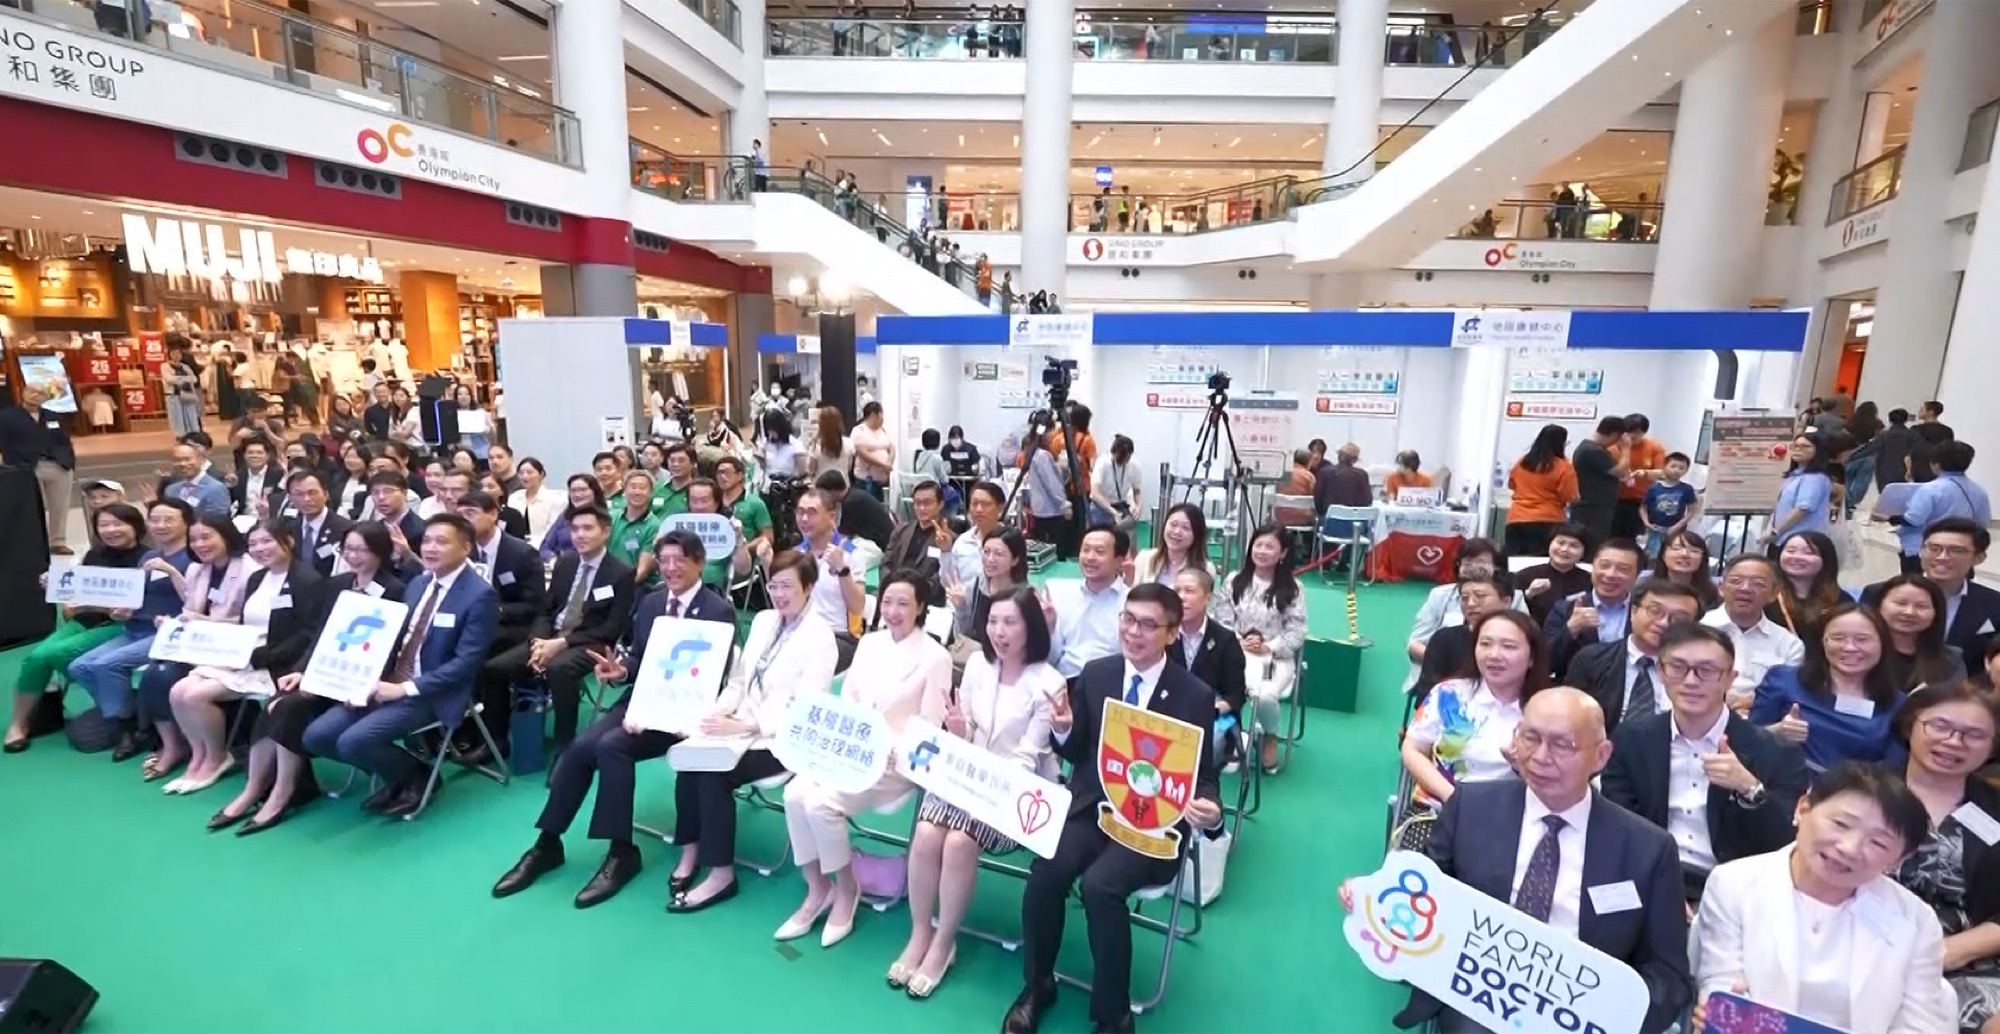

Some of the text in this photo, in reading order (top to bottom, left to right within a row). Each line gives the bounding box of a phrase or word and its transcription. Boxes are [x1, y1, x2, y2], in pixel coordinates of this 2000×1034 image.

[45, 41, 144, 76] GROUP
[357, 123, 415, 164] OC
[418, 159, 501, 191] Olympian City
[121, 213, 281, 283] MUJI
[1485, 242, 1517, 267] OC
[91, 359, 111, 375] 25
[127, 390, 145, 405] 25
[808, 704, 873, 743] 基層醫療
[789, 724, 875, 768] 共同治理網絡
[1473, 908, 1601, 989] WORLD
[1464, 931, 1587, 1006] FAMILY
